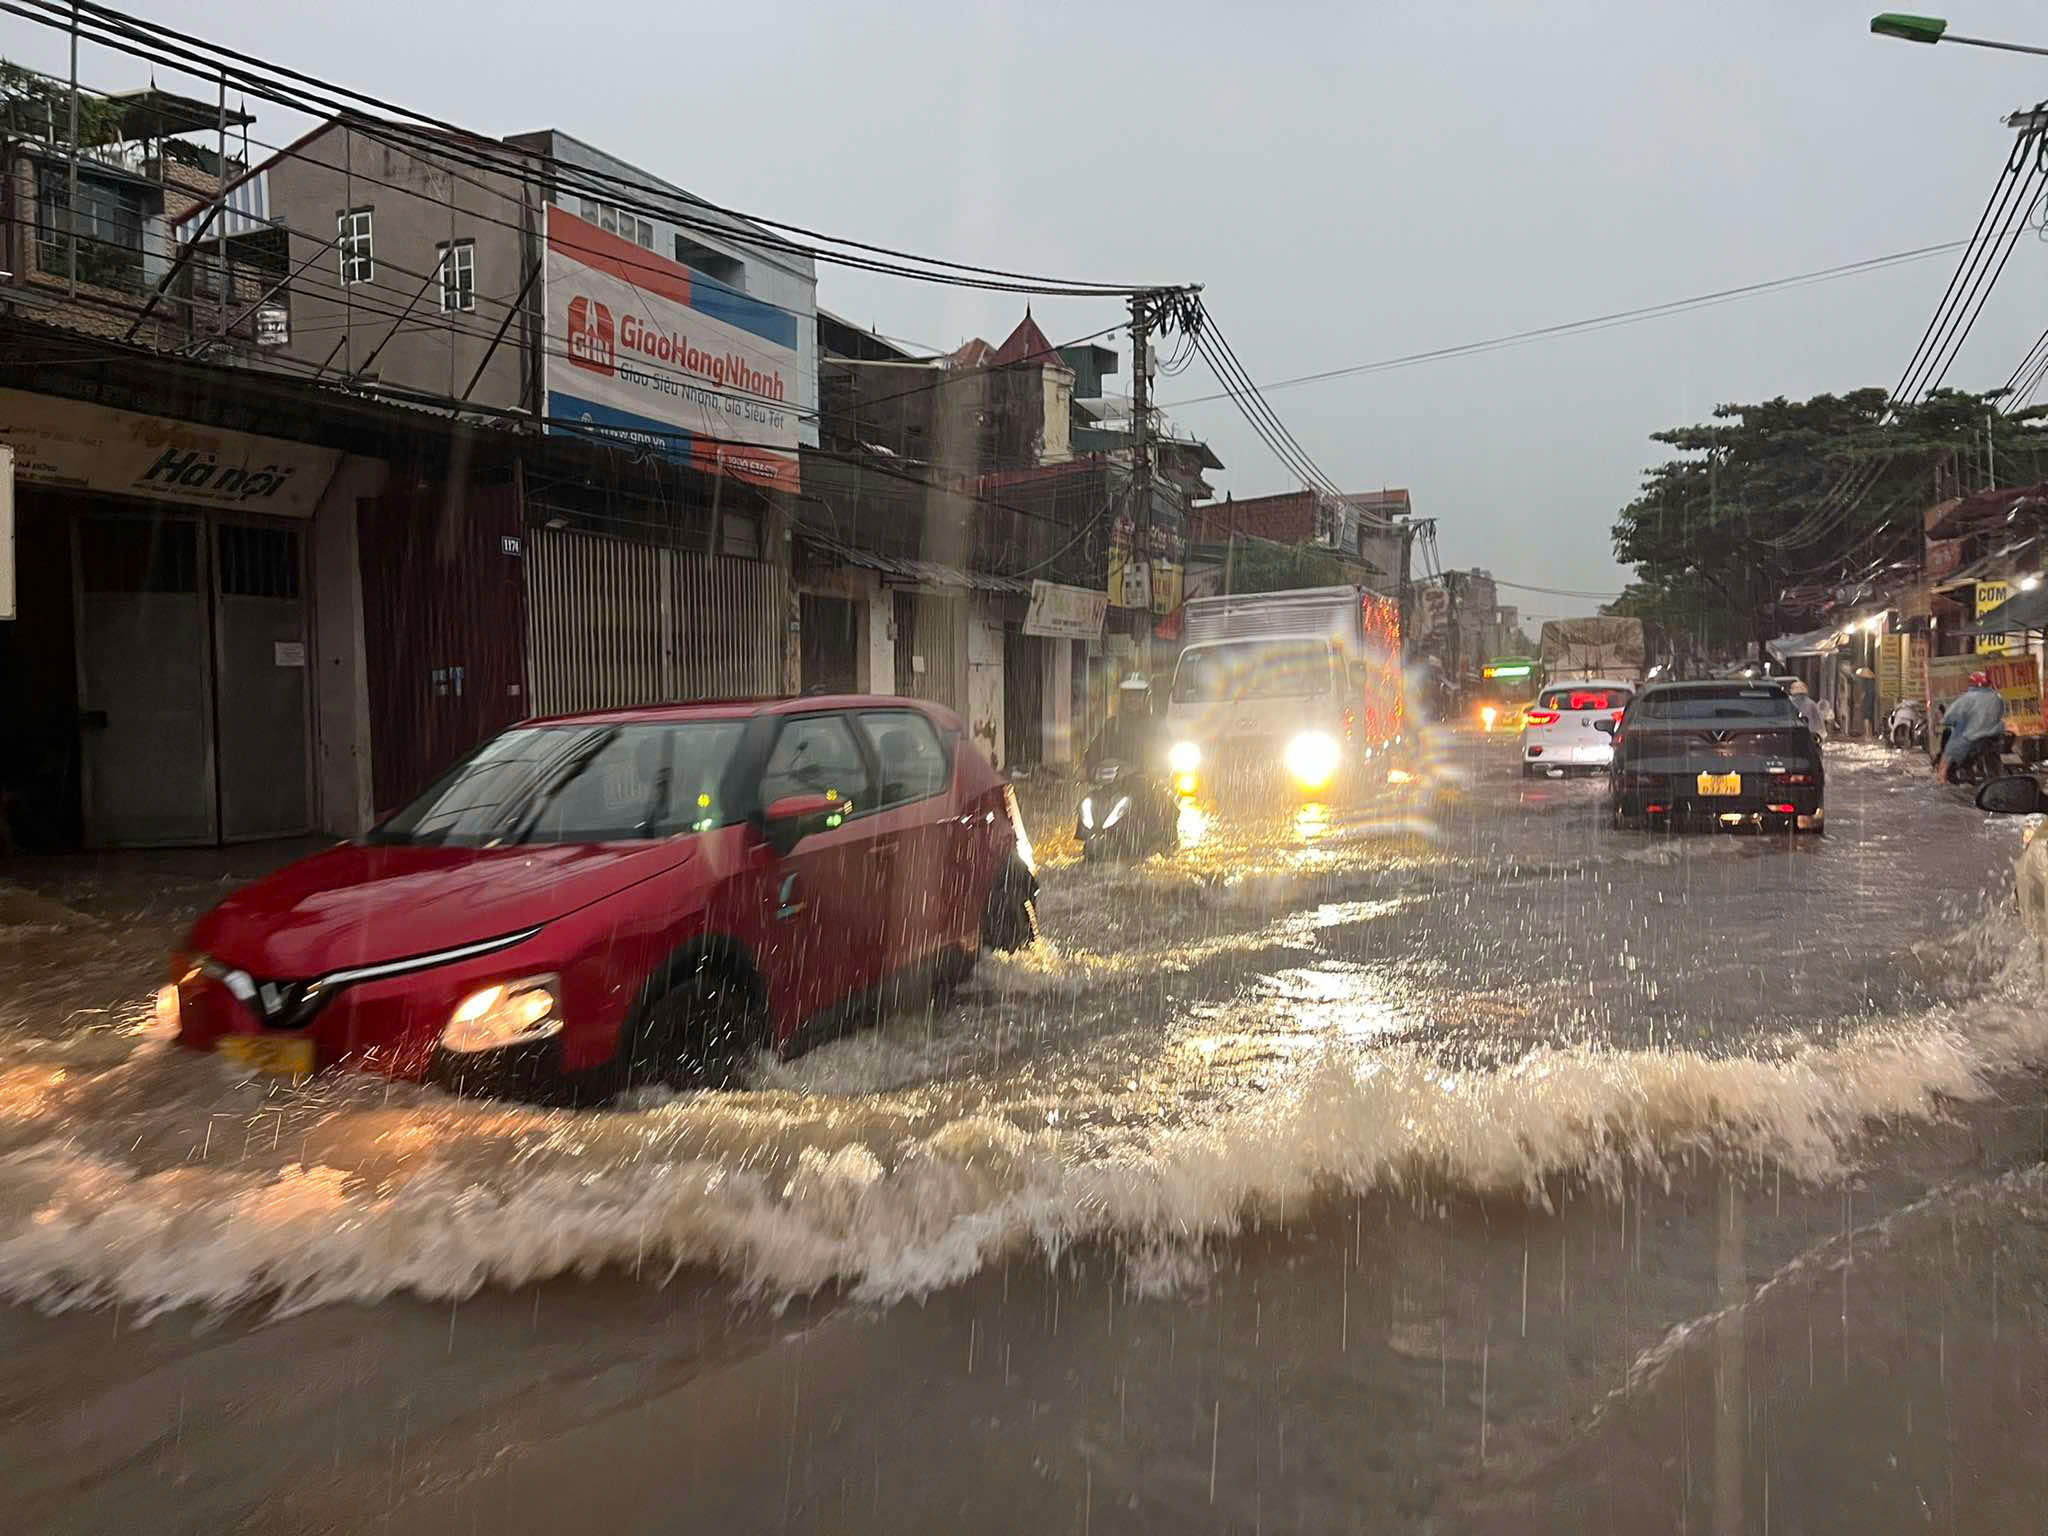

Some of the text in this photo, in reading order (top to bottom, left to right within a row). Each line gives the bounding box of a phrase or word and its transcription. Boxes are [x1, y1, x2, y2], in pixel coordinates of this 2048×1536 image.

[620, 314, 785, 403] GiaoHangNhanh
[620, 362, 649, 387] Giao
[653, 373, 679, 396] Siêu
[144, 447, 220, 487] Hà
